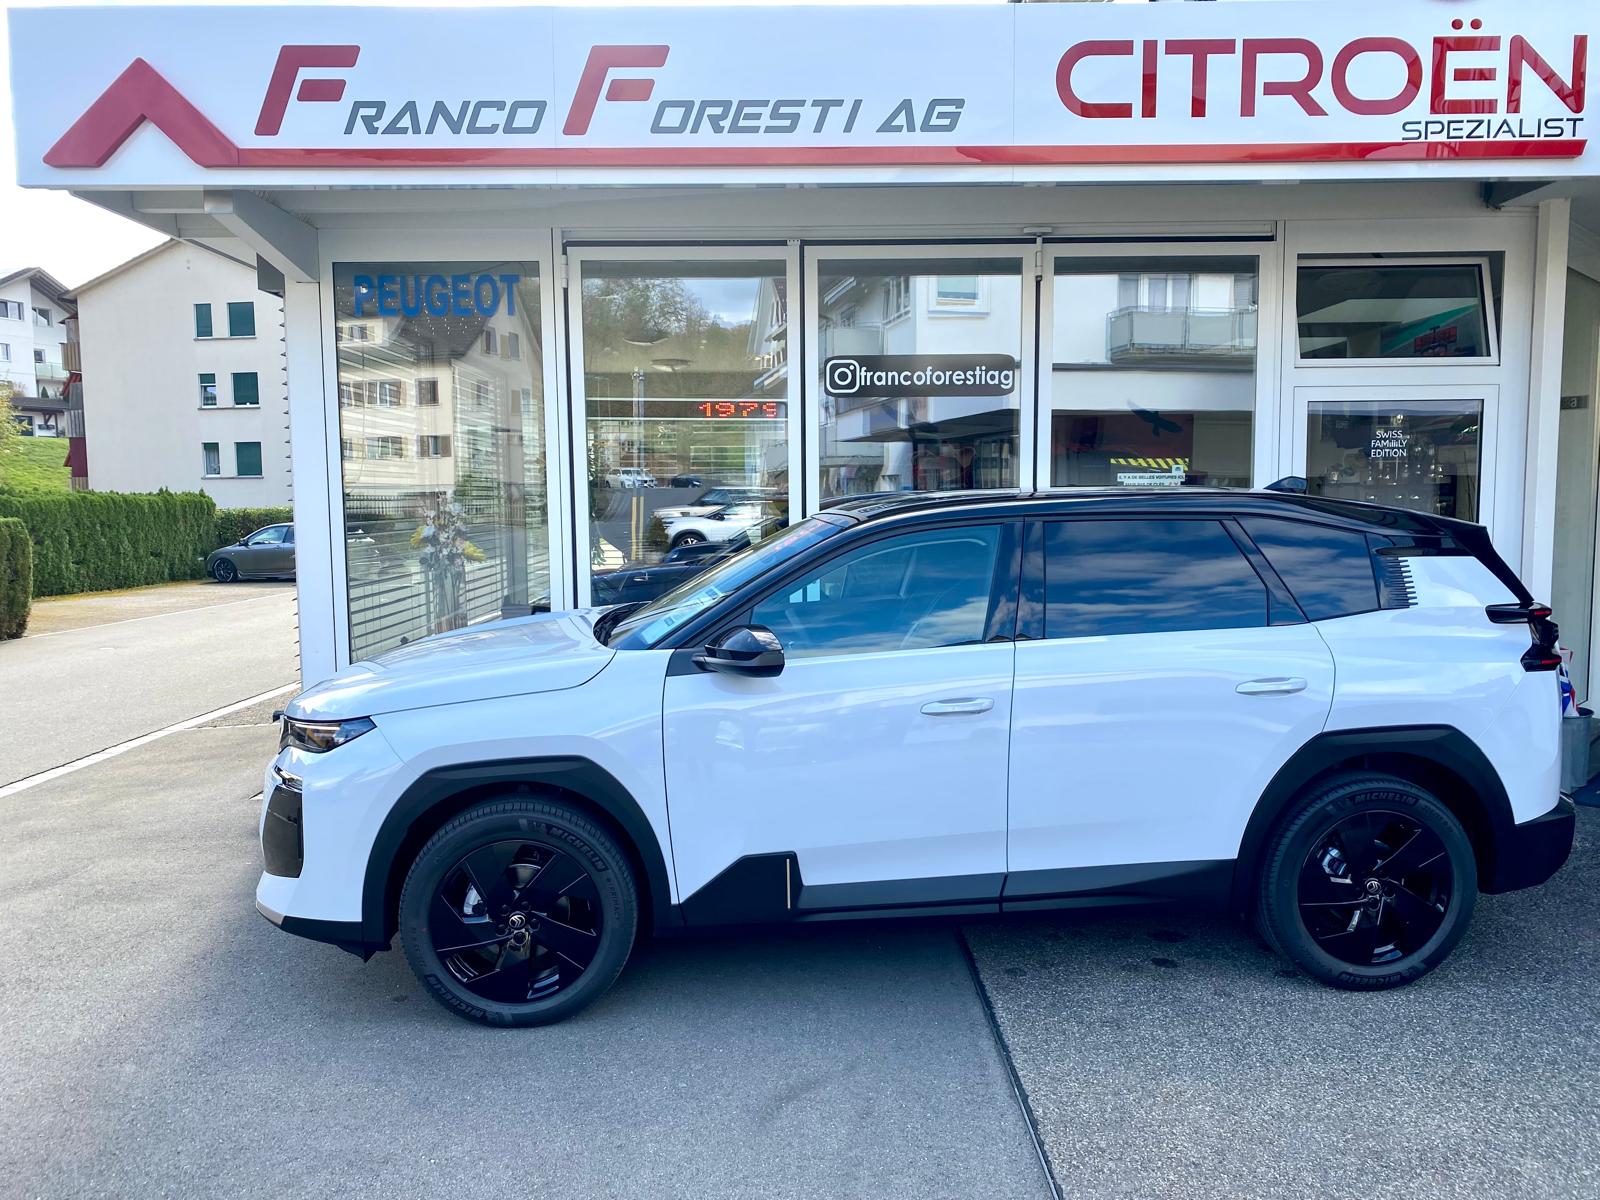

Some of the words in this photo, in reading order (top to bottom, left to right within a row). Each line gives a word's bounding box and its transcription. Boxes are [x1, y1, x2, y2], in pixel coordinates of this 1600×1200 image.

[1056, 18, 1588, 119] CITROËN
[254, 45, 547, 136] FRANCO
[562, 45, 863, 136] FORESTI
[876, 98, 965, 133] AG
[1401, 117, 1584, 141] SPEZIALIST
[354, 273, 520, 317] PEUGEOT
[860, 366, 1013, 390] francoforestiag
[1376, 430, 1403, 439] SWISS
[1371, 449, 1407, 458] EDITION
[1354, 792, 1416, 805] MICHELIN
[549, 828, 606, 870] MICHELIN
